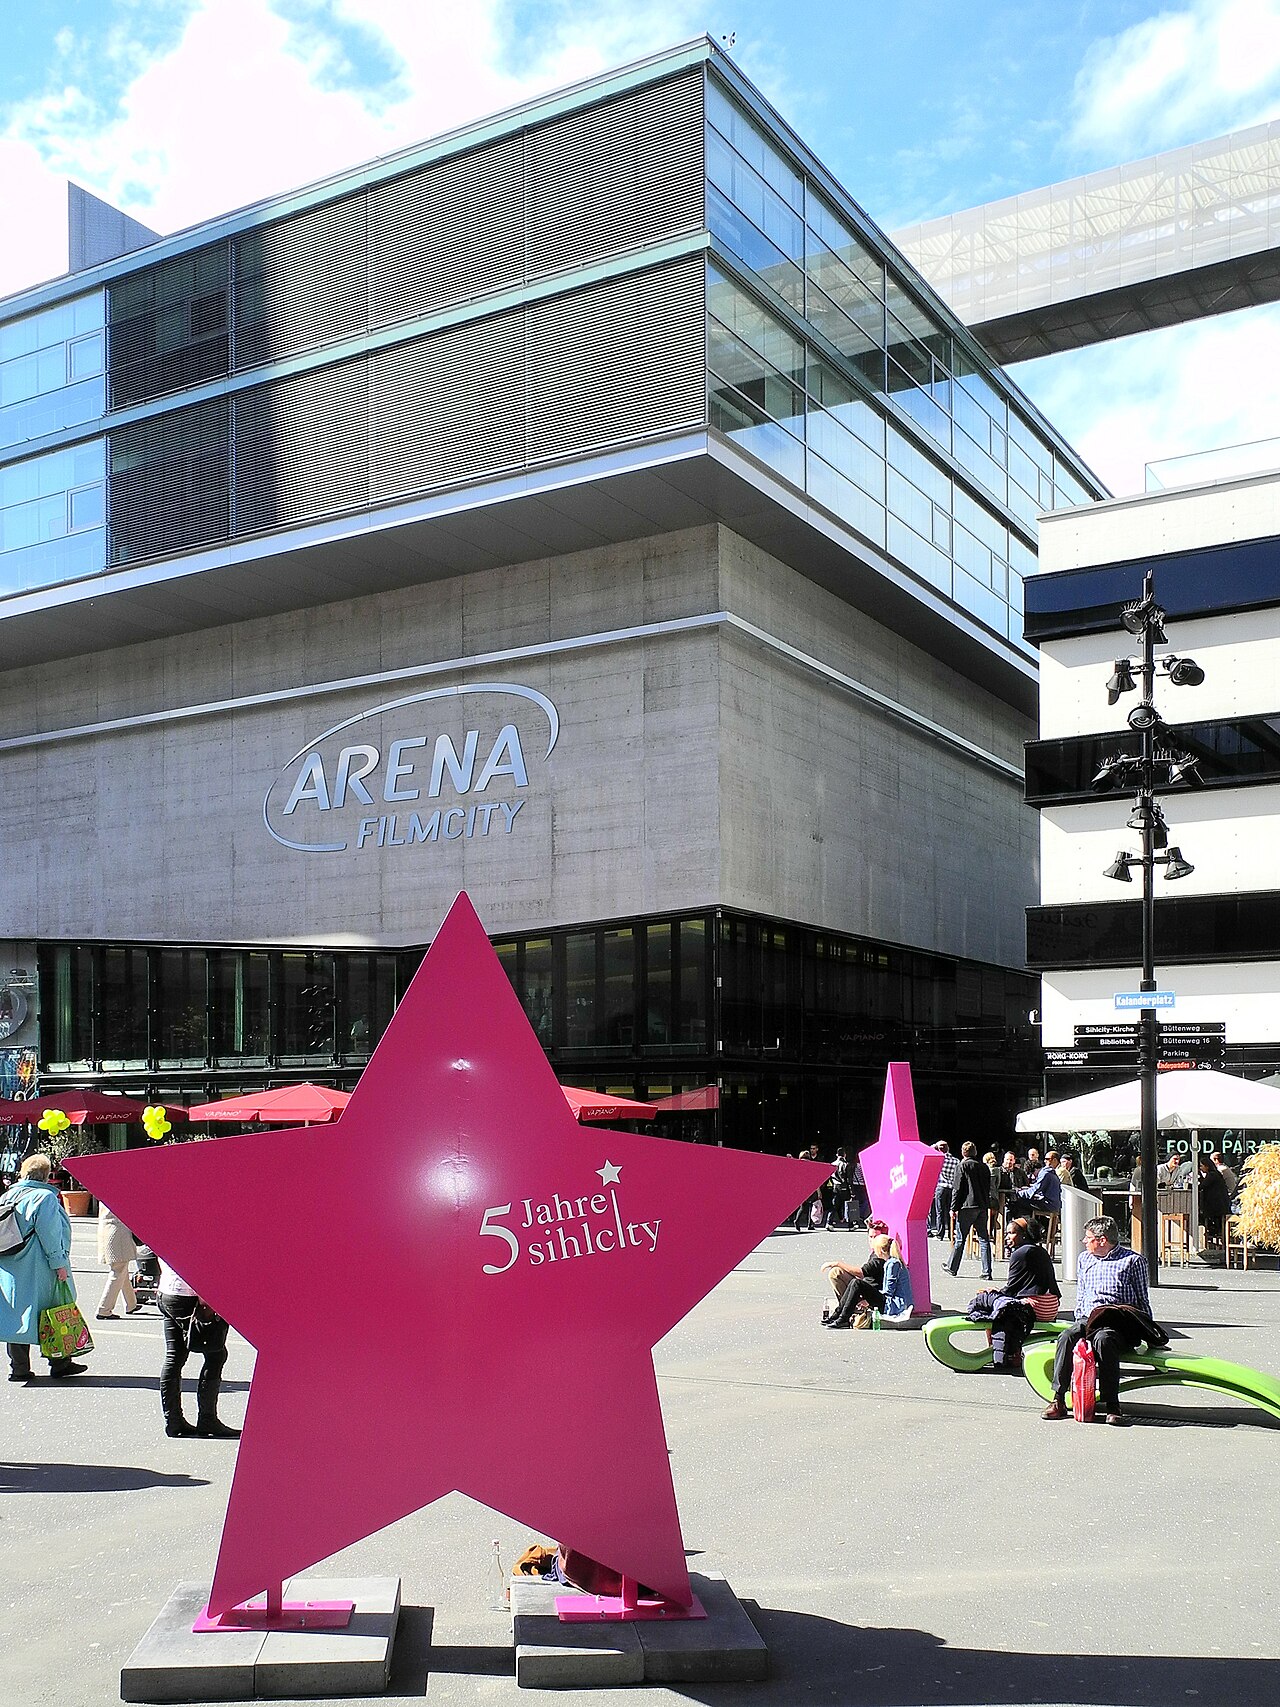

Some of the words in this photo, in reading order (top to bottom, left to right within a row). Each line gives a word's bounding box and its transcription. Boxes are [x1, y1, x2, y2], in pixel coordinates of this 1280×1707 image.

[283, 725, 529, 815] ARENA
[357, 801, 525, 848] FILMCITY
[1116, 995, 1173, 1007] Kalanderplatz
[1162, 1037, 1201, 1045] Büttenweg
[1166, 1140, 1215, 1154] FOOD
[479, 1202, 520, 1275] 5
[521, 1193, 608, 1228] Jahre
